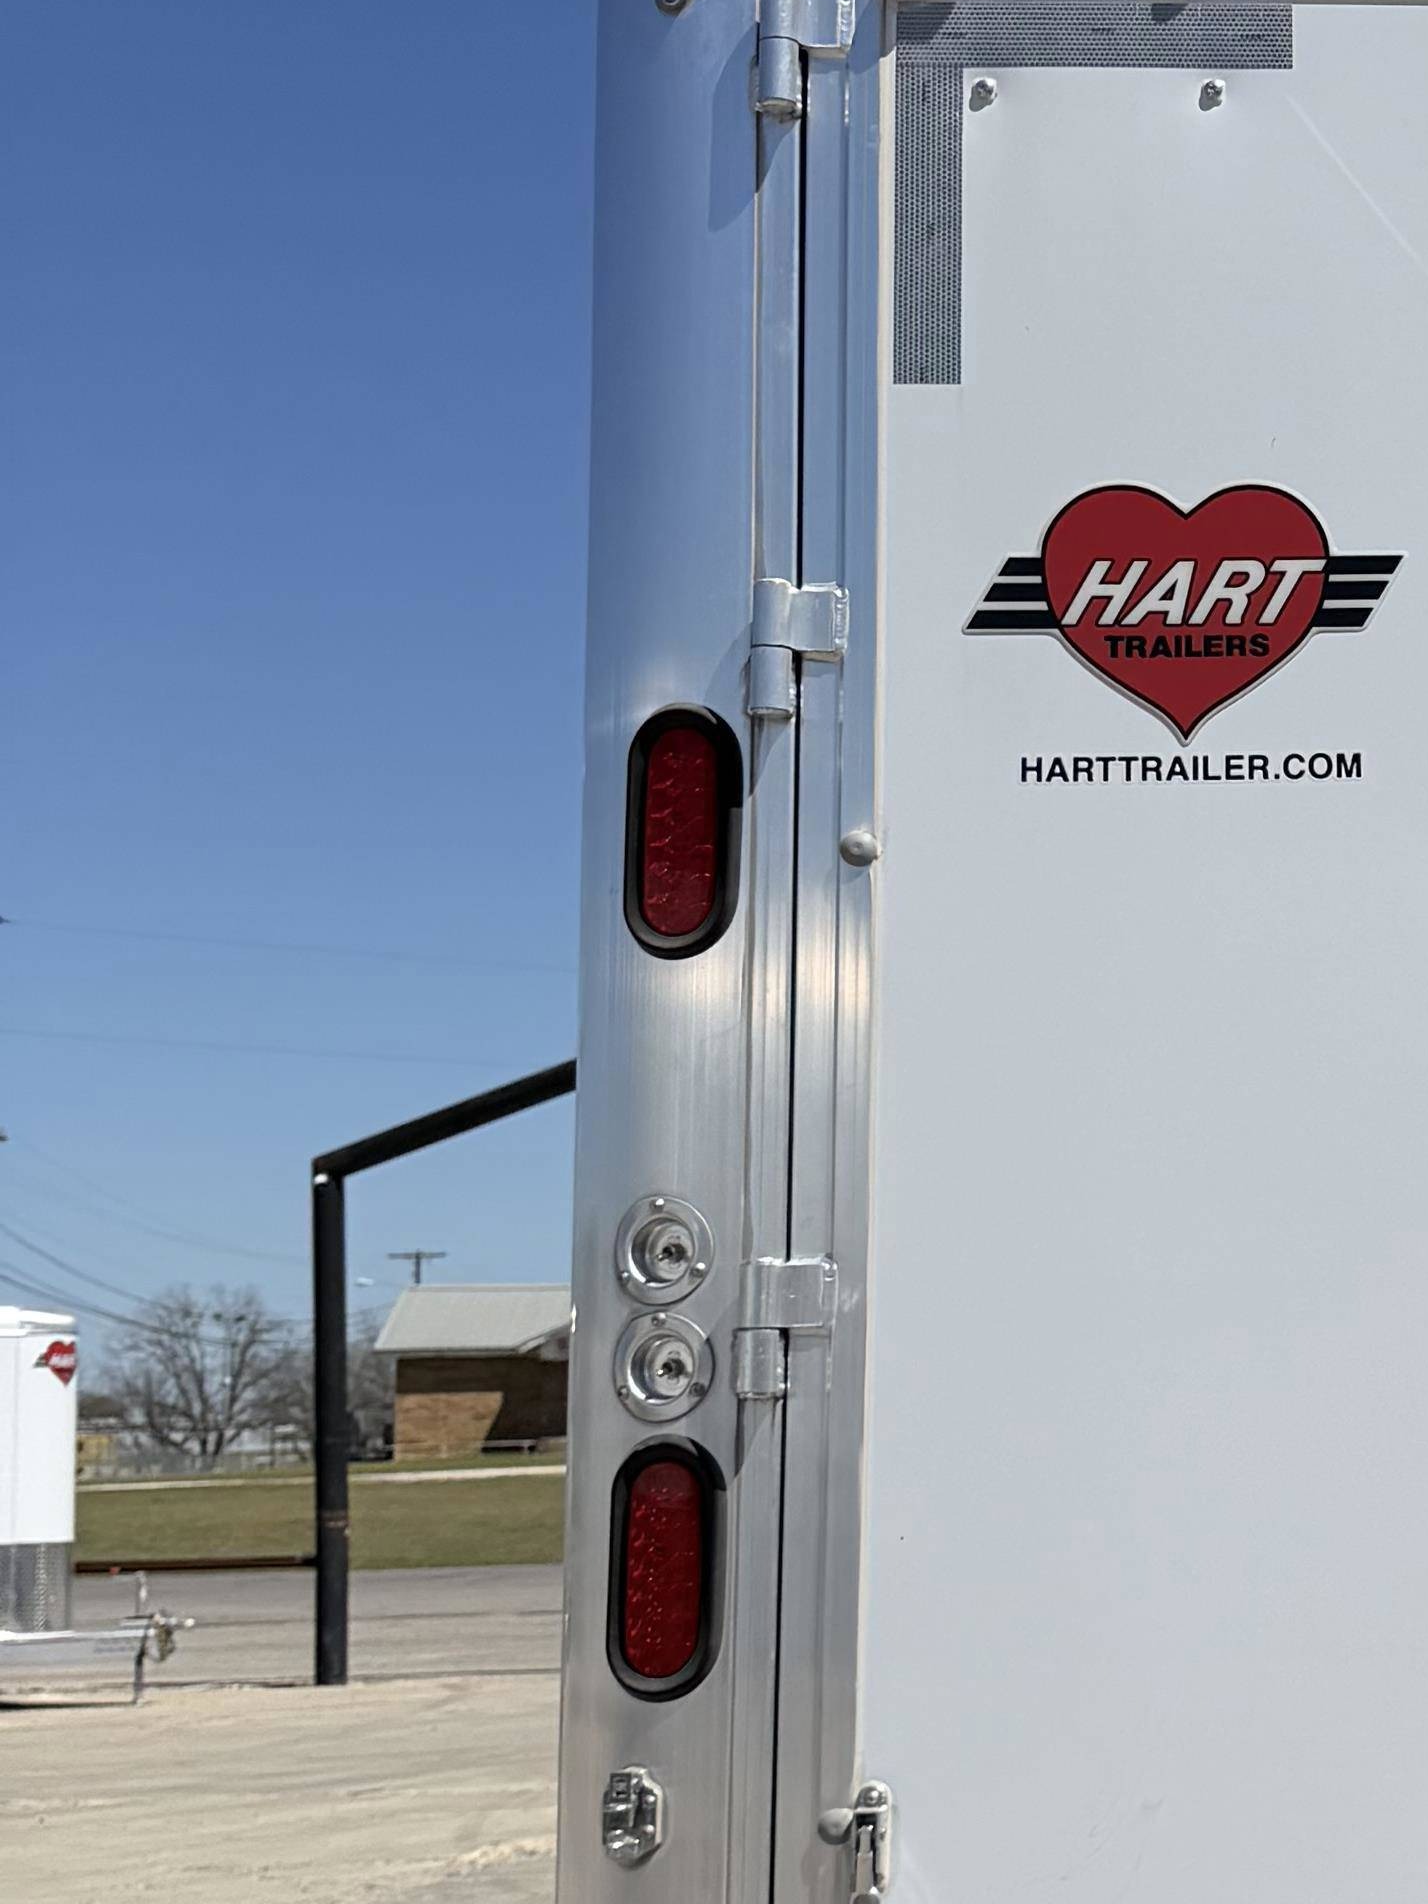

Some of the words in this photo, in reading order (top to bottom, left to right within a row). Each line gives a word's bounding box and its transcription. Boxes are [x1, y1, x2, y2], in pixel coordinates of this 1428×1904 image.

[1060, 557, 1328, 626] HART
[1103, 632, 1270, 658] TRAILERS
[1020, 752, 1363, 784] HARTTRAILER.COM
